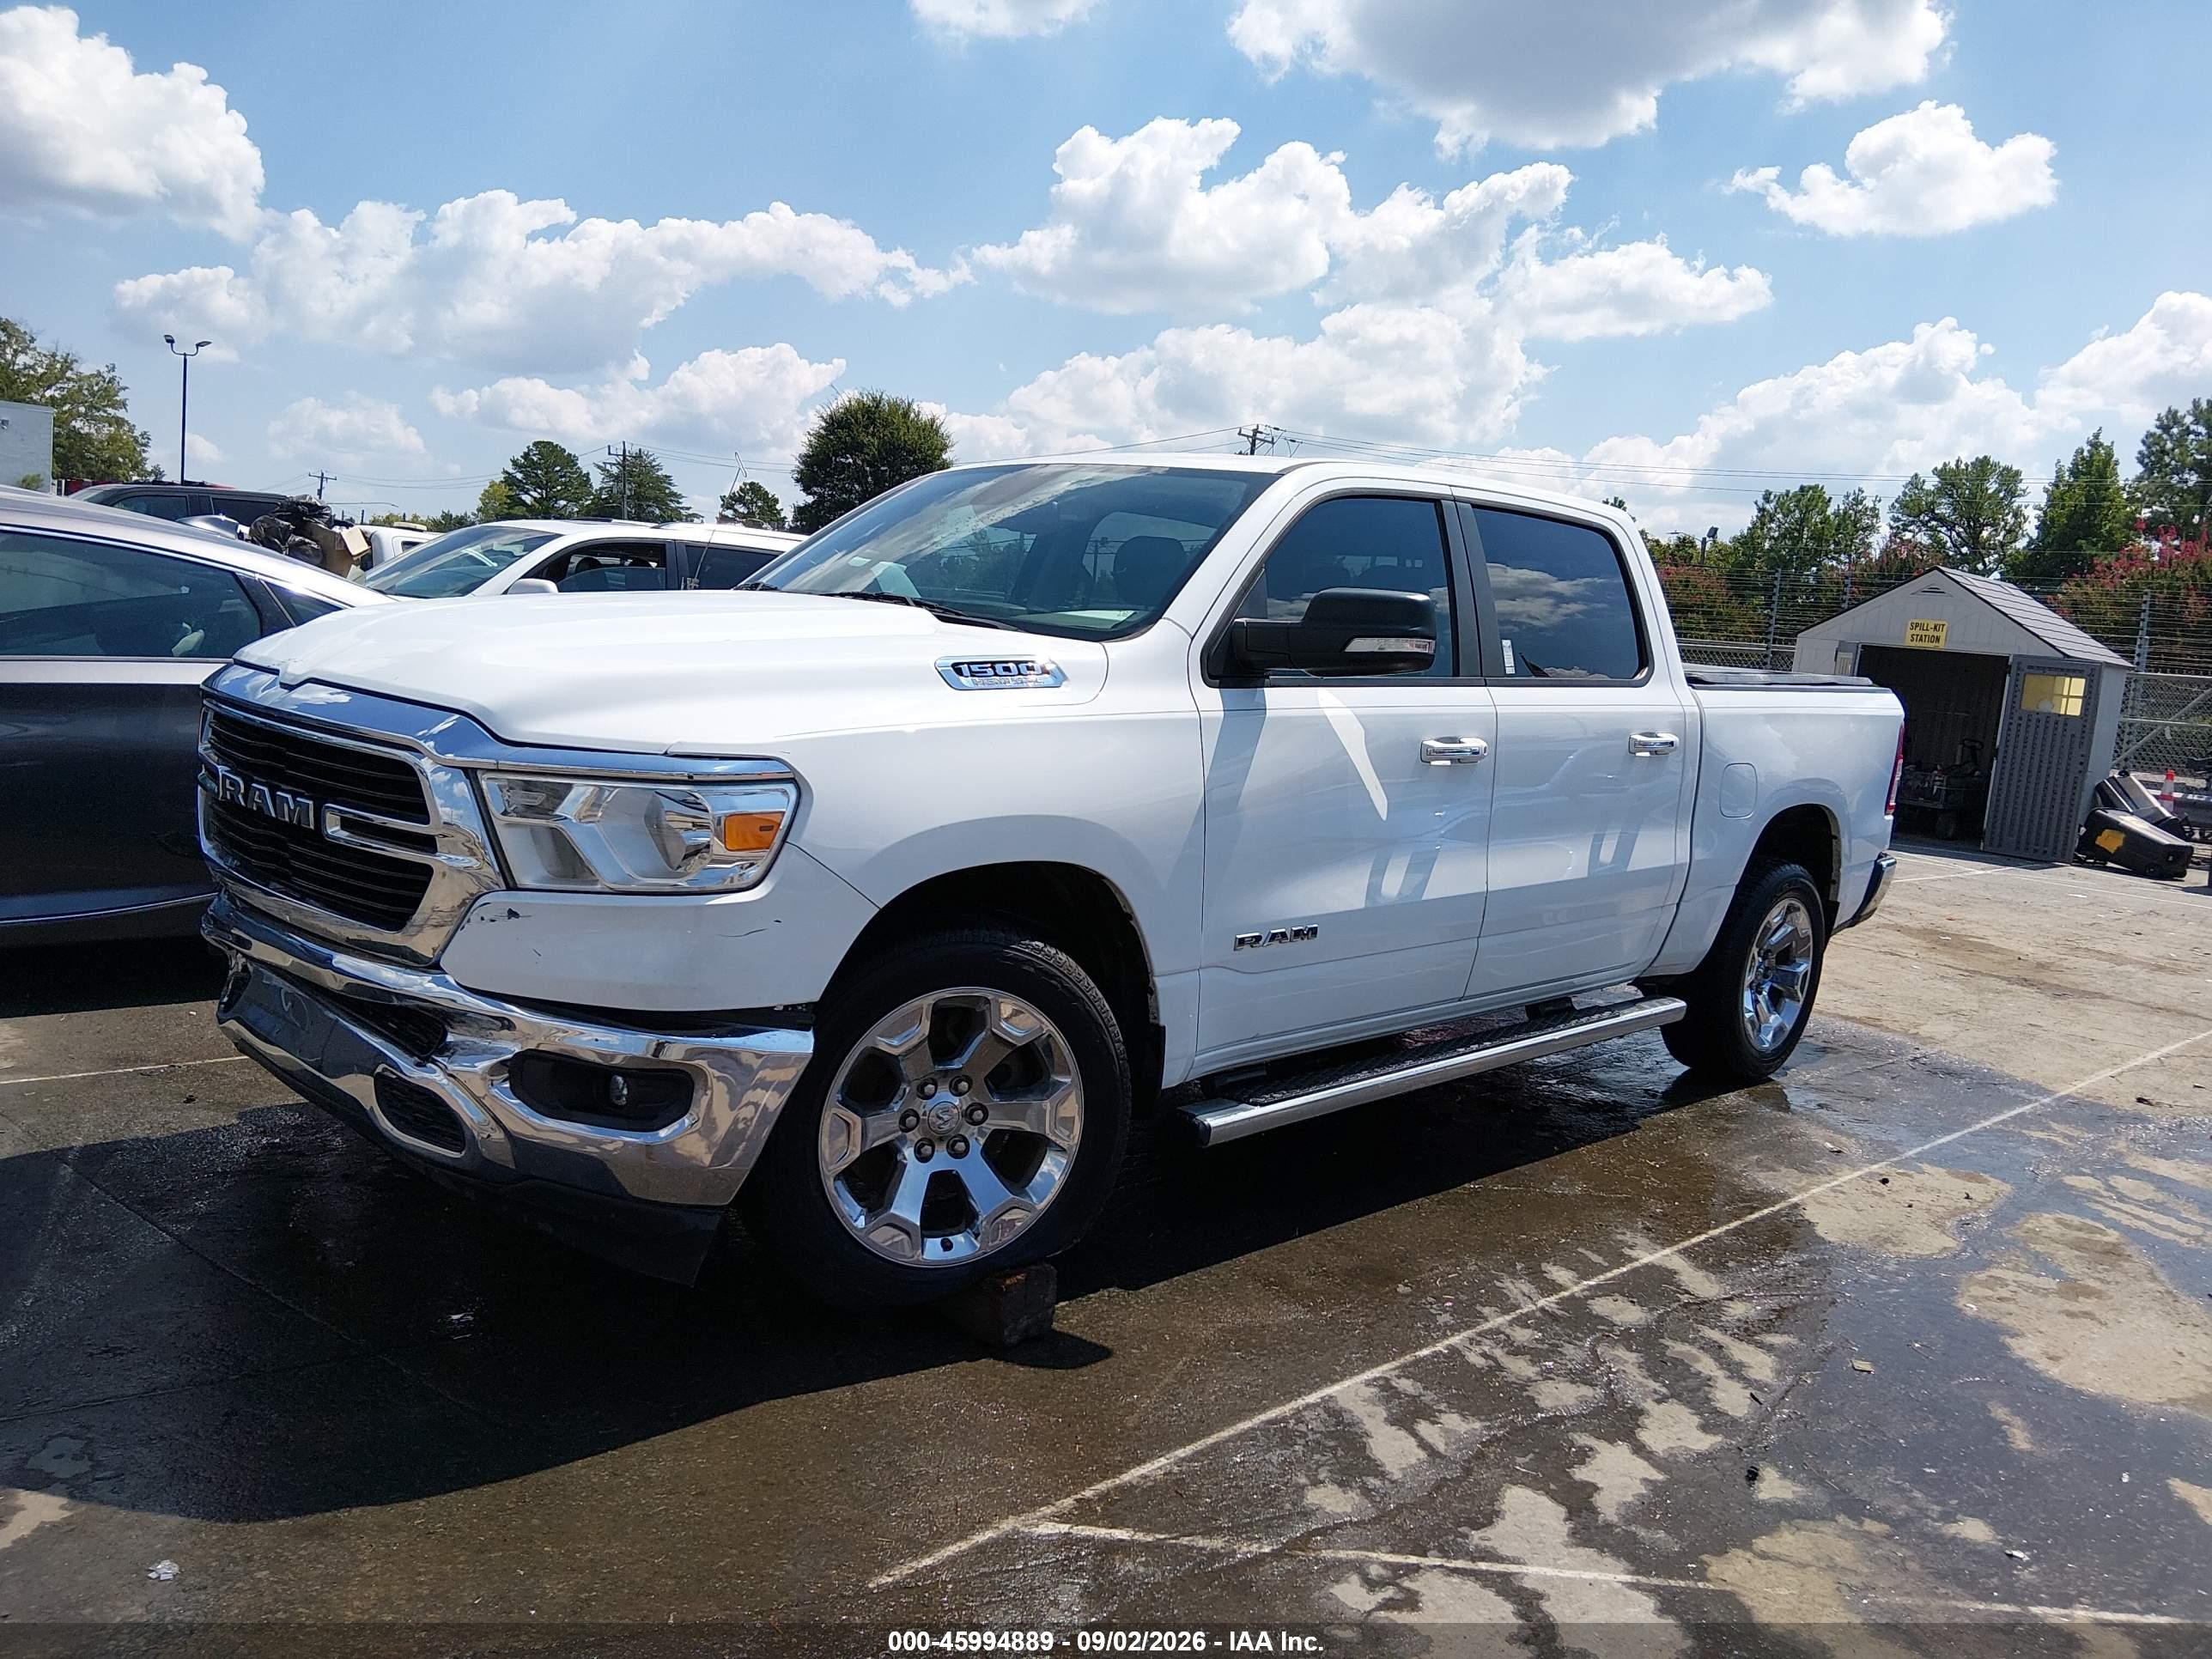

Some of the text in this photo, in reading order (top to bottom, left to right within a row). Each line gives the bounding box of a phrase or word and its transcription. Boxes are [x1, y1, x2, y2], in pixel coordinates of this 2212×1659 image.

[1909, 622, 1946, 633] SPILL-KIT
[1910, 634, 1941, 644] STATION
[954, 662, 1042, 678] 1500
[218, 769, 315, 830] RAM
[1233, 924, 1319, 951] RAM
